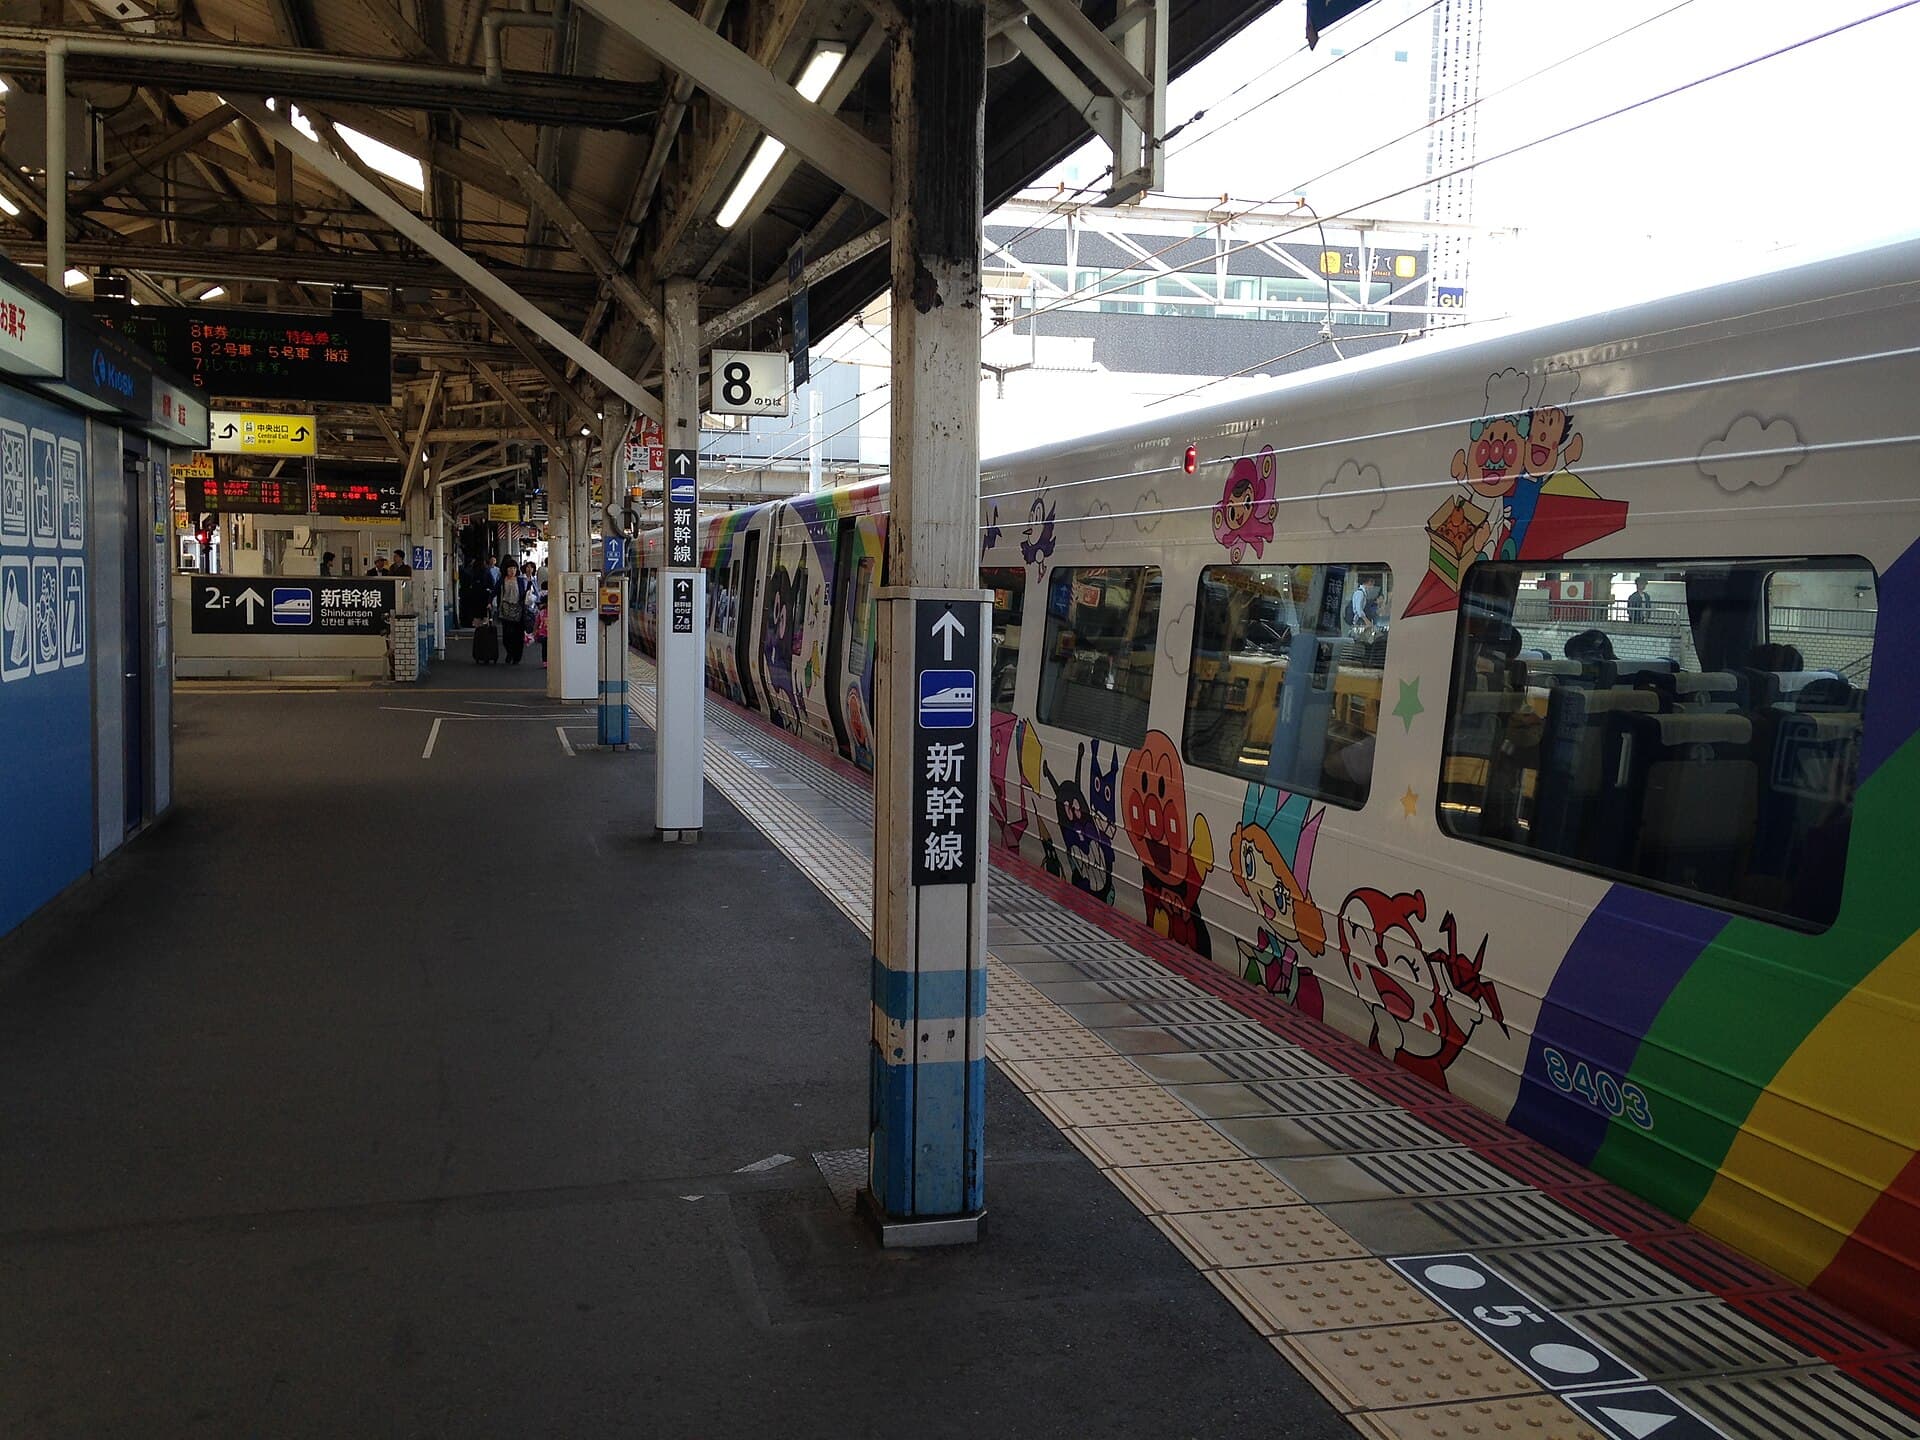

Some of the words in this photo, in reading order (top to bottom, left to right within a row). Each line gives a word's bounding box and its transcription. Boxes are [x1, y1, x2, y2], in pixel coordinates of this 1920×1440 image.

[1439, 293, 1464, 308] GU
[0, 299, 26, 342] お菓子
[722, 362, 752, 406] 8
[754, 397, 782, 407] のりば
[257, 424, 289, 433] 中央出口
[673, 507, 692, 563] 新幹線
[204, 587, 231, 609] 2F
[320, 588, 382, 608] 新幹線
[320, 608, 373, 618] Shinkansen
[924, 742, 965, 872] 新幹線
[1543, 1047, 1654, 1131] 8403
